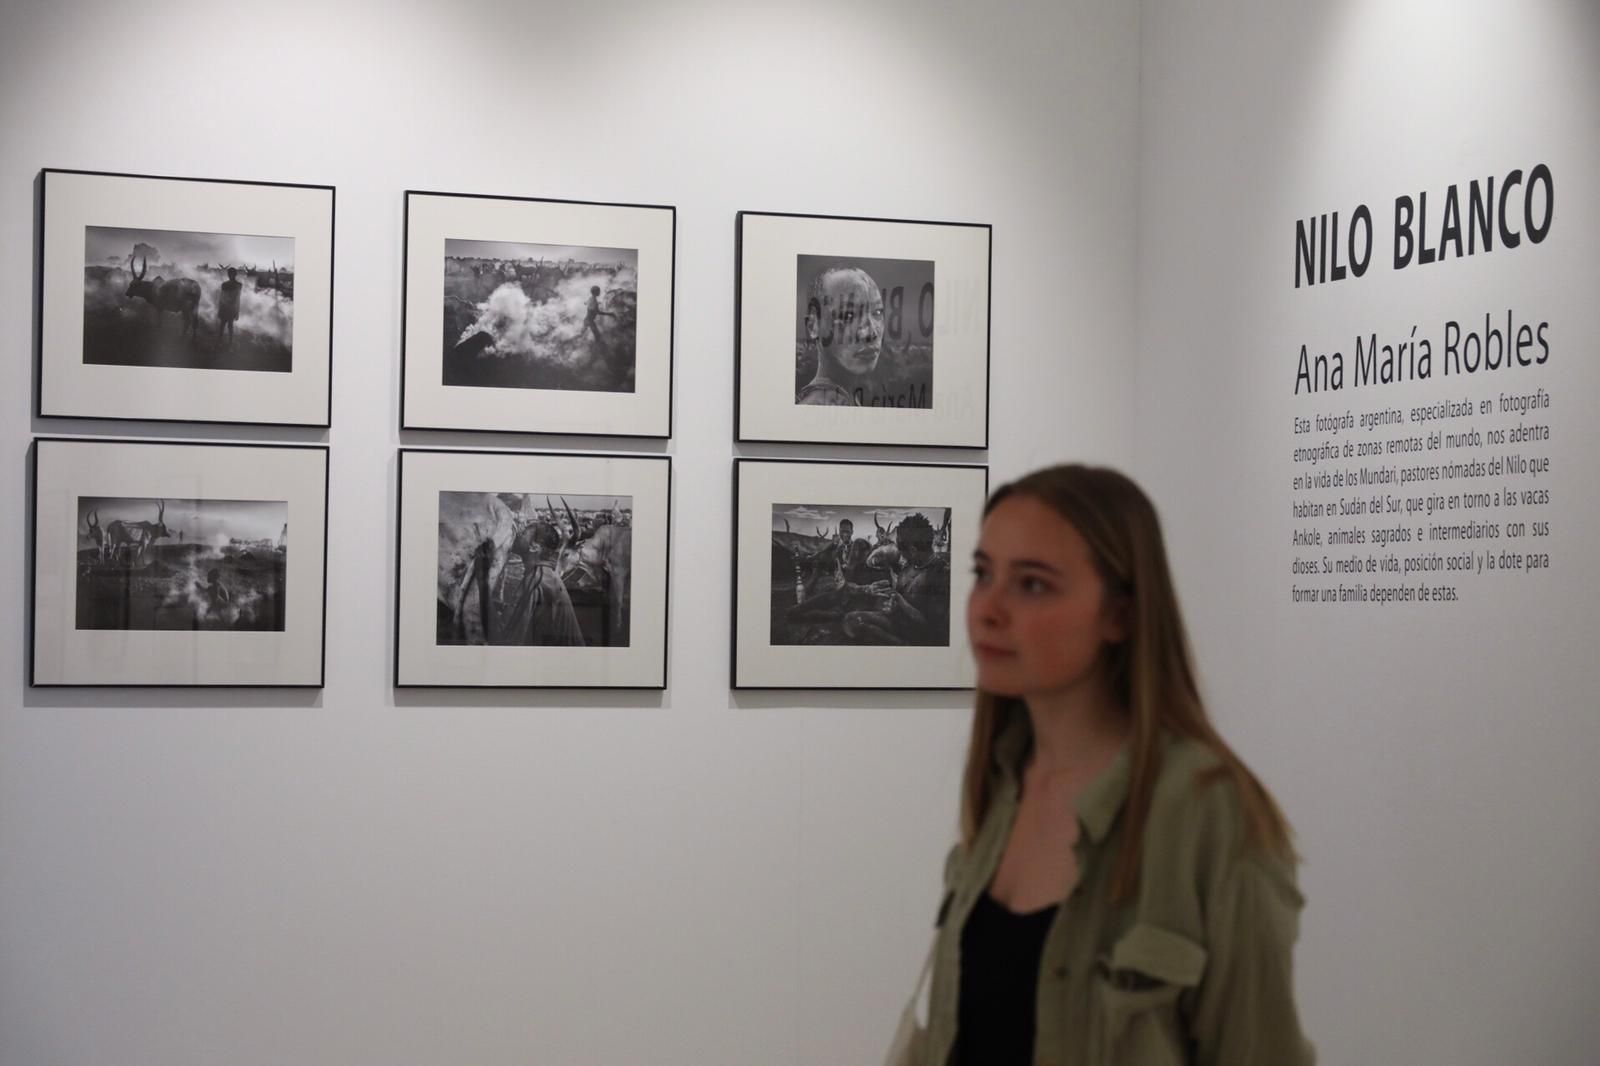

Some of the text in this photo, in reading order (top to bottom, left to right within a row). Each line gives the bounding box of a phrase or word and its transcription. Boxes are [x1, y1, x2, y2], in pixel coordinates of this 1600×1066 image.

[1295, 163, 1554, 288] NILO BLANCO
[1294, 309, 1549, 395] Ana María Robles
[1294, 389, 1550, 435] Esta fotógrafa argentina, especializada en fotografía
[1294, 423, 1550, 464] etnográfica de zonas remotas del mundo, nos adentra
[1293, 456, 1550, 489] en la vida de los Mundari, pastores nómadas del Nilo que
[1293, 487, 1550, 517] habitan en Sudán del Sur, que gira en torno a las vacas
[1292, 521, 1550, 547] Ankole, animales sagrados e intermediarios con sus
[1292, 550, 1550, 576] dioses. Su medio de vida, posición social y la dote para
[1292, 583, 1459, 605] formar una familia dependen de estas.
